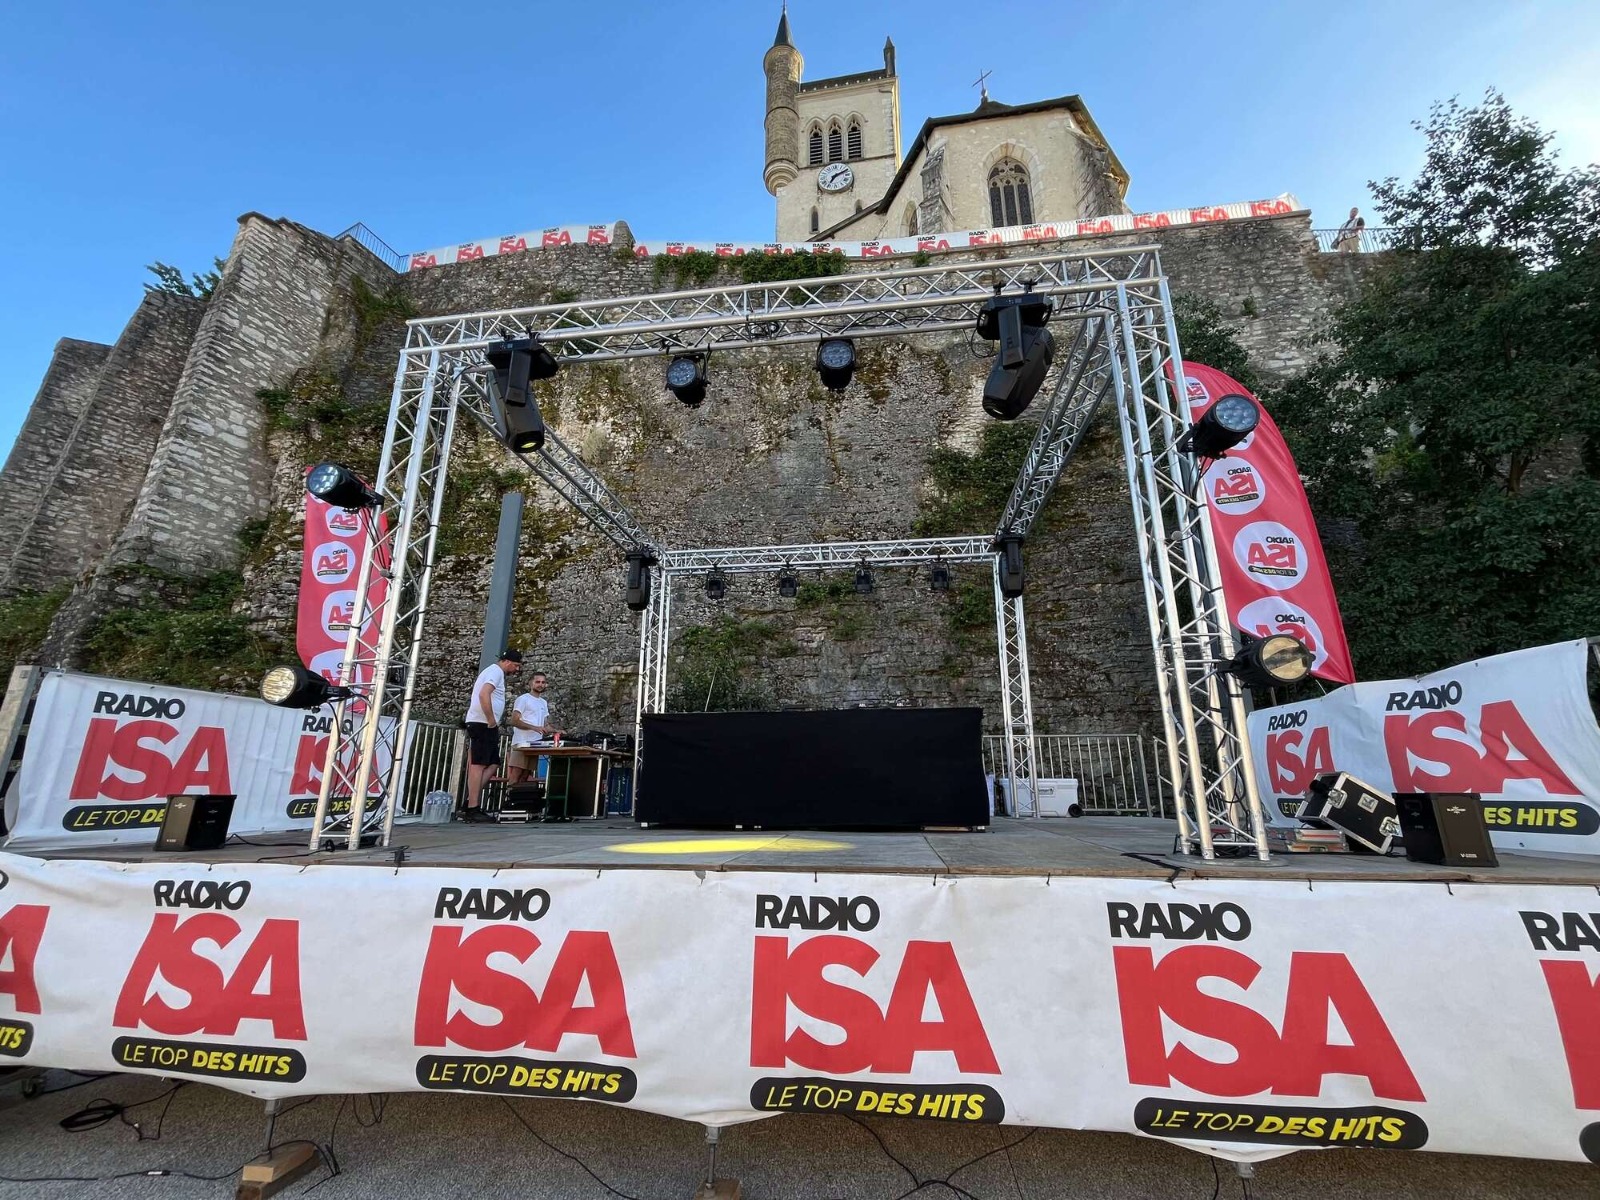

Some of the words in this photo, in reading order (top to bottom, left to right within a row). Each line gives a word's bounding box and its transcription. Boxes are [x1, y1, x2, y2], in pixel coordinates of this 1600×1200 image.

[1133, 213, 1171, 229] ISA
[1251, 201, 1292, 217] ISA
[499, 238, 527, 253] ISA
[542, 231, 571, 246] ISA
[587, 230, 608, 245] IS
[861, 246, 894, 258] ISA
[918, 240, 951, 252] ISA
[411, 255, 436, 270] ISA
[457, 245, 484, 262] ISA
[93, 691, 186, 719] RADIO
[1386, 681, 1462, 711] RADIO
[1268, 710, 1308, 731] RADIO
[69, 718, 232, 801] ISA
[1266, 726, 1336, 795] ISA
[1384, 700, 1585, 796] ISA
[73, 811, 99, 827] LE
[102, 810, 141, 825] TOP
[140, 809, 166, 824] DE
[293, 803, 309, 815] LE
[1483, 807, 1512, 826] ES
[1516, 808, 1578, 828] HITS
[153, 880, 251, 910] RADIO
[434, 887, 550, 922] RADIO
[755, 893, 880, 932] RADIO
[1106, 901, 1252, 942] RADIO
[112, 912, 308, 1041] ISA
[414, 923, 637, 1059] ISA
[750, 934, 1002, 1075] ISA
[1112, 944, 1427, 1103] ISA
[123, 1044, 146, 1062] LE
[150, 1046, 188, 1065] TOP
[192, 1050, 236, 1071] DES
[238, 1053, 292, 1076] HITS
[429, 1063, 457, 1081] LE
[462, 1063, 508, 1085] TOP
[509, 1065, 562, 1091] DES
[561, 1069, 623, 1094] HITS
[765, 1085, 799, 1107] LE
[803, 1085, 852, 1109] TOP
[855, 1090, 916, 1115] DES
[917, 1094, 986, 1120] HITS
[1150, 1109, 1189, 1128] LE
[1193, 1112, 1254, 1131] TOP
[1255, 1115, 1327, 1138] DES
[1329, 1116, 1406, 1142] HITS
